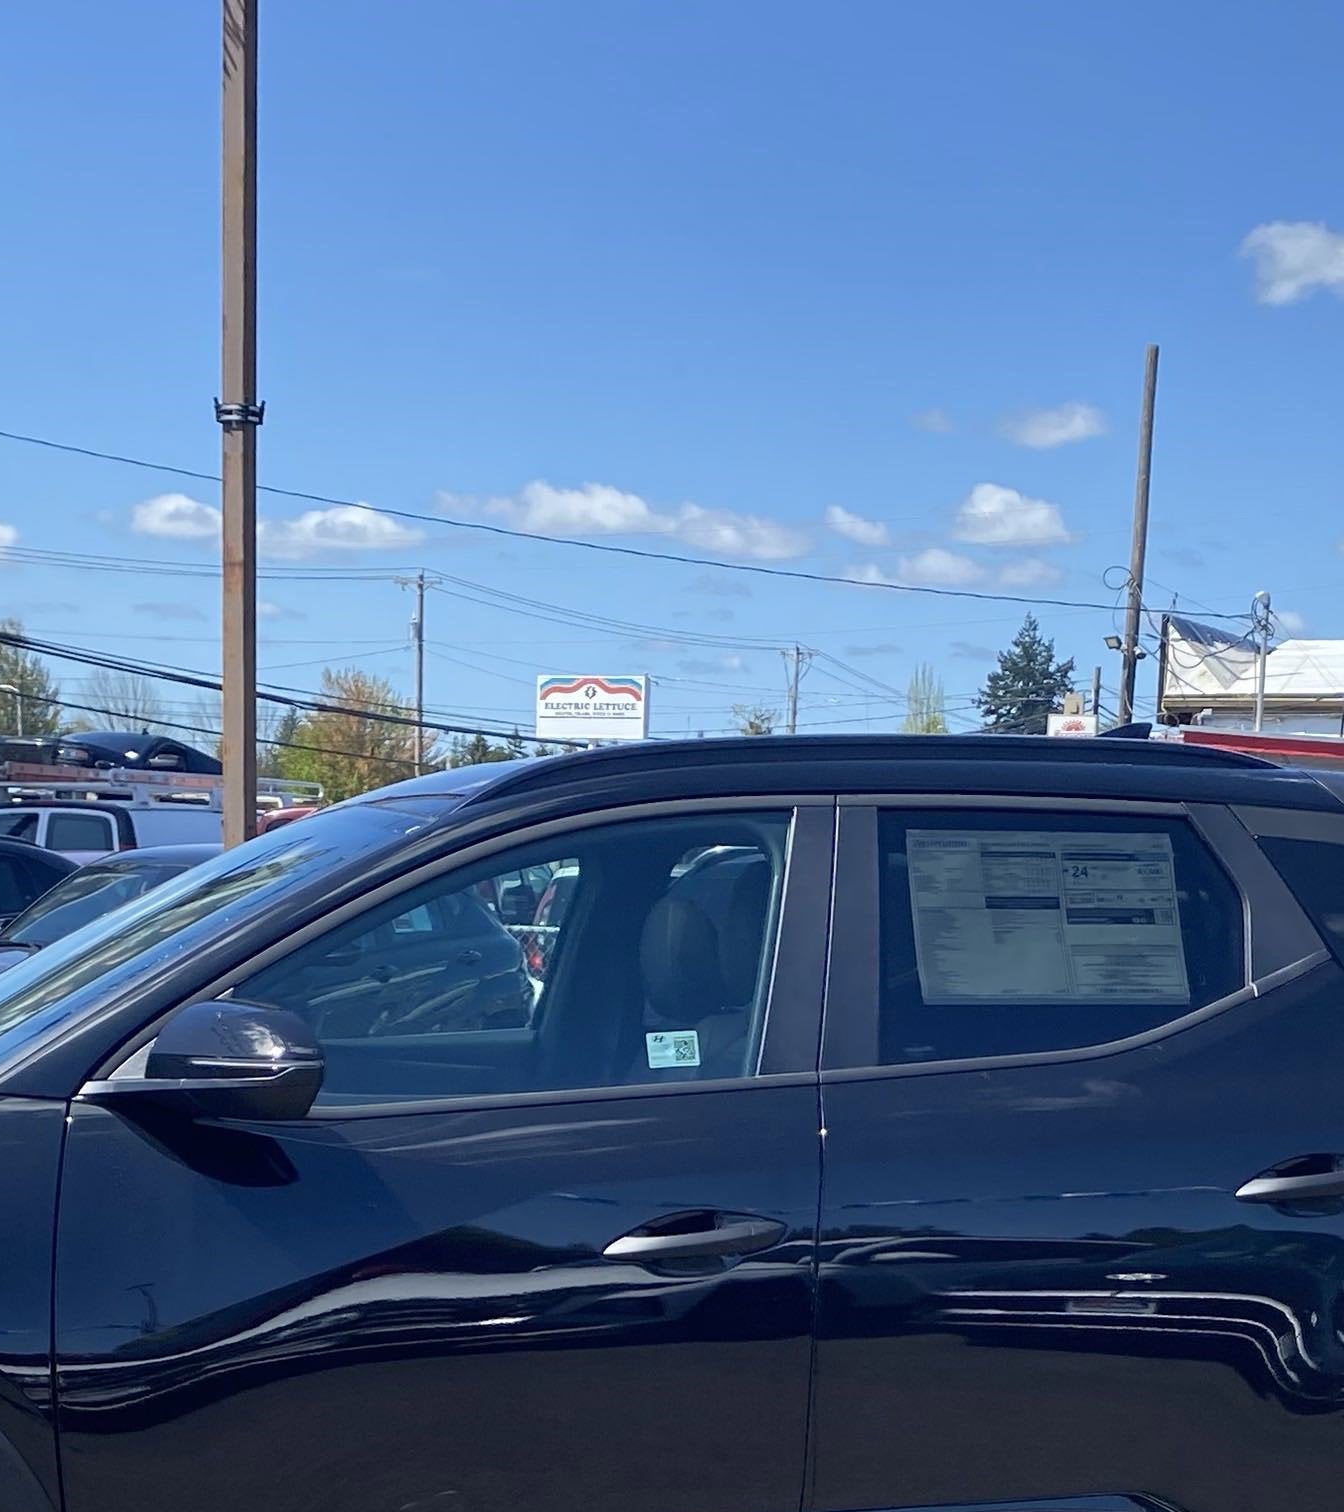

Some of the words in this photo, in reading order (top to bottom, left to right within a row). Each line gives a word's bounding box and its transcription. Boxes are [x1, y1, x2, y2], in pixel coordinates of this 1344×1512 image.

[544, 702, 590, 711] ELECTRIC
[593, 702, 638, 712] LETTUCE
[1071, 865, 1089, 878] 24
